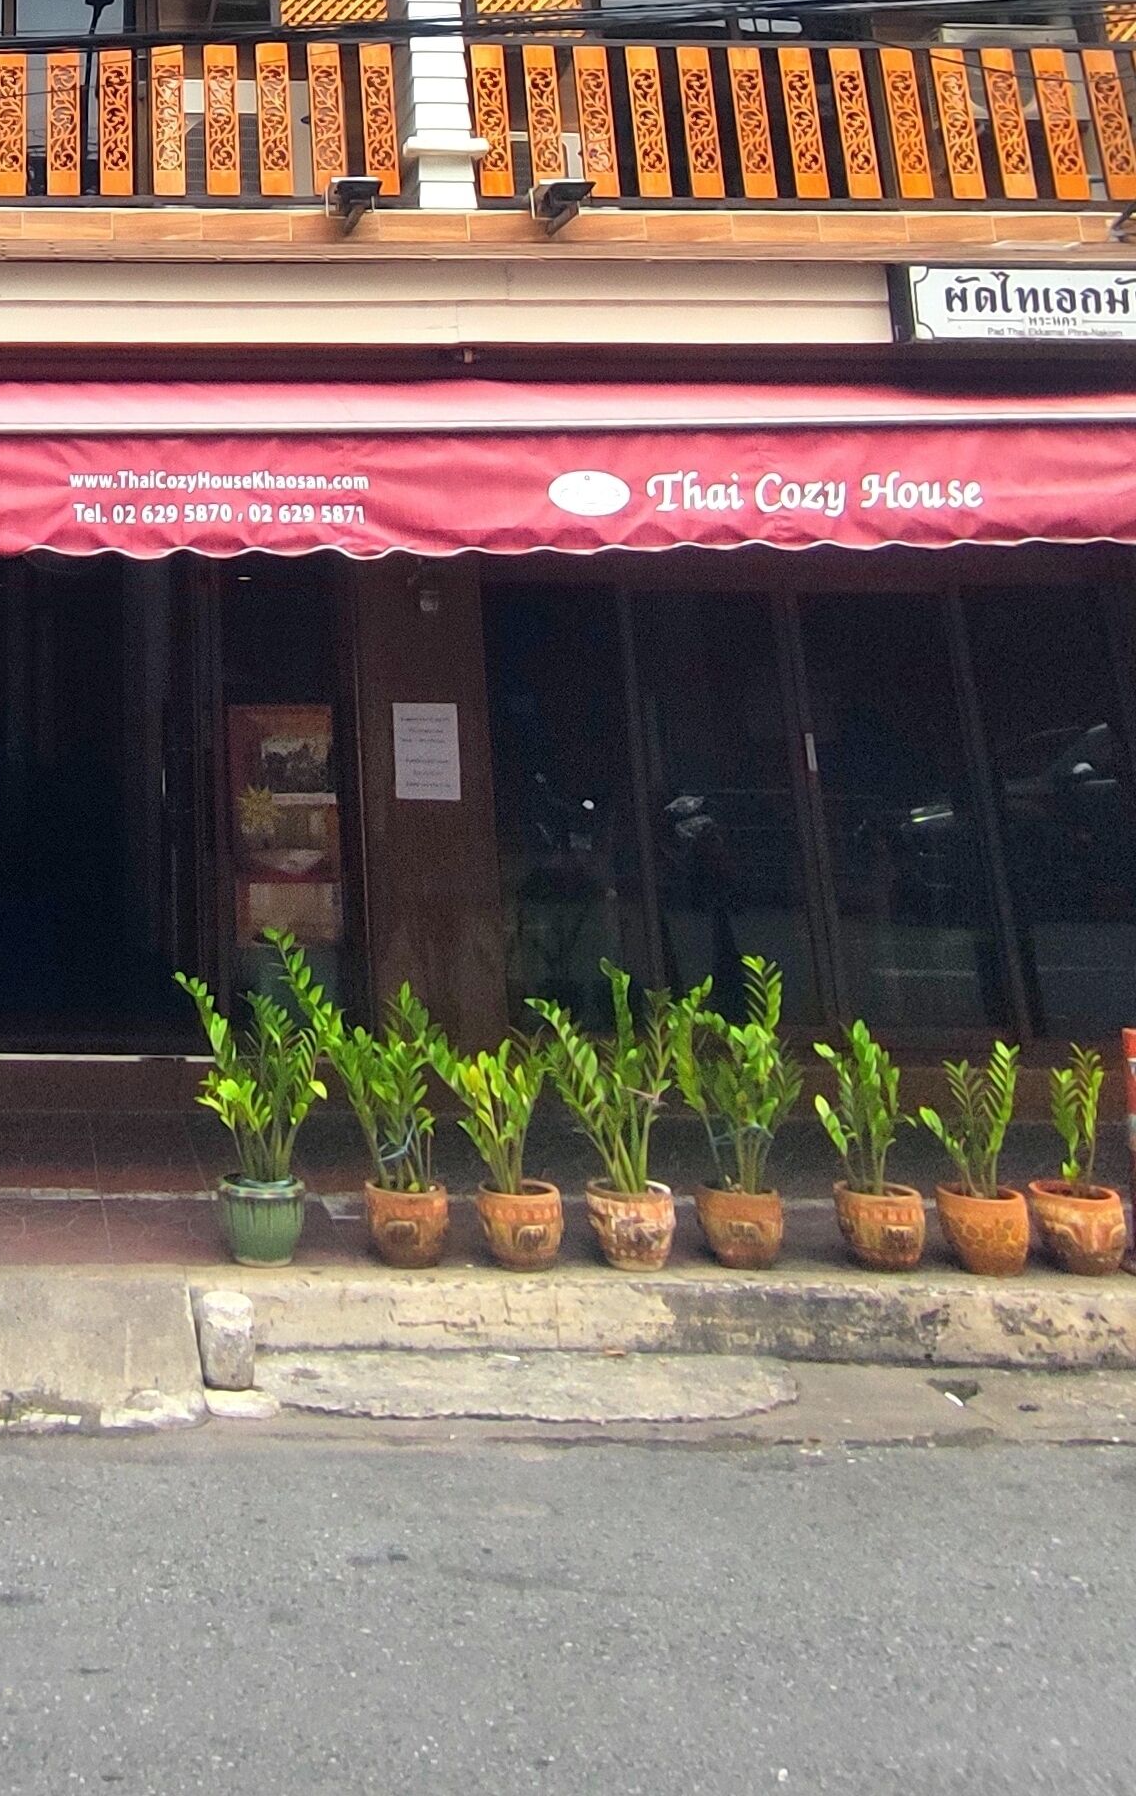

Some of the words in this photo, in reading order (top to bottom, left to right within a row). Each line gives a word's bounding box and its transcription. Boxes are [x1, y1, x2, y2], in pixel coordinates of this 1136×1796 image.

[945, 271, 1136, 314] ผัดไทเอกมั
[987, 326, 1005, 336] Pad
[69, 470, 369, 494] www.ThaiCozyHouseKhaosan.com
[646, 470, 745, 512] Thai
[754, 472, 847, 518] Cozy
[860, 470, 984, 509] House
[72, 503, 108, 524] Tel.
[112, 504, 137, 524] 02
[141, 504, 178, 524] 629
[248, 503, 273, 523] 02
[278, 504, 315, 524] 629
[320, 505, 365, 525] 5871
